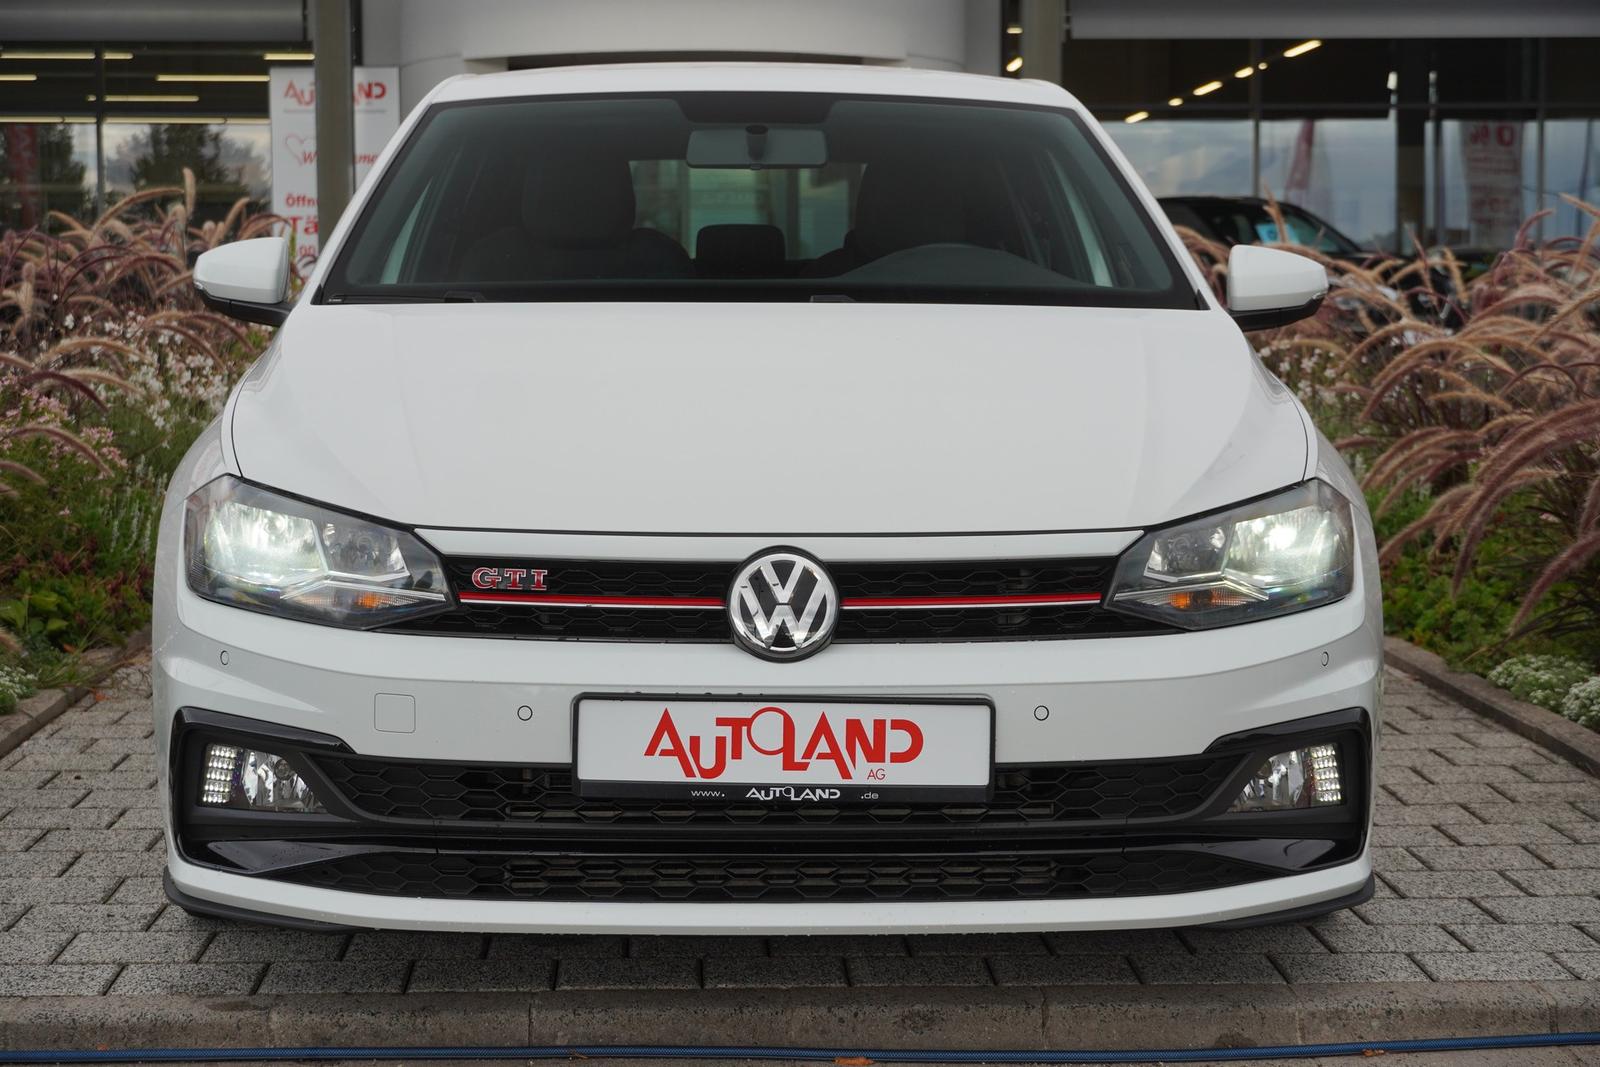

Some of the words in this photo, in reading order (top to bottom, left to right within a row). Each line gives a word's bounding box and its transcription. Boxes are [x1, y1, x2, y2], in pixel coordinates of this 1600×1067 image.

[471, 567, 549, 591] GTI
[643, 706, 924, 780] AUTOLAND
[866, 767, 887, 781] AG
[690, 789, 725, 798] www.
[745, 786, 841, 802] AUTOLAND
[860, 791, 880, 800] .de
